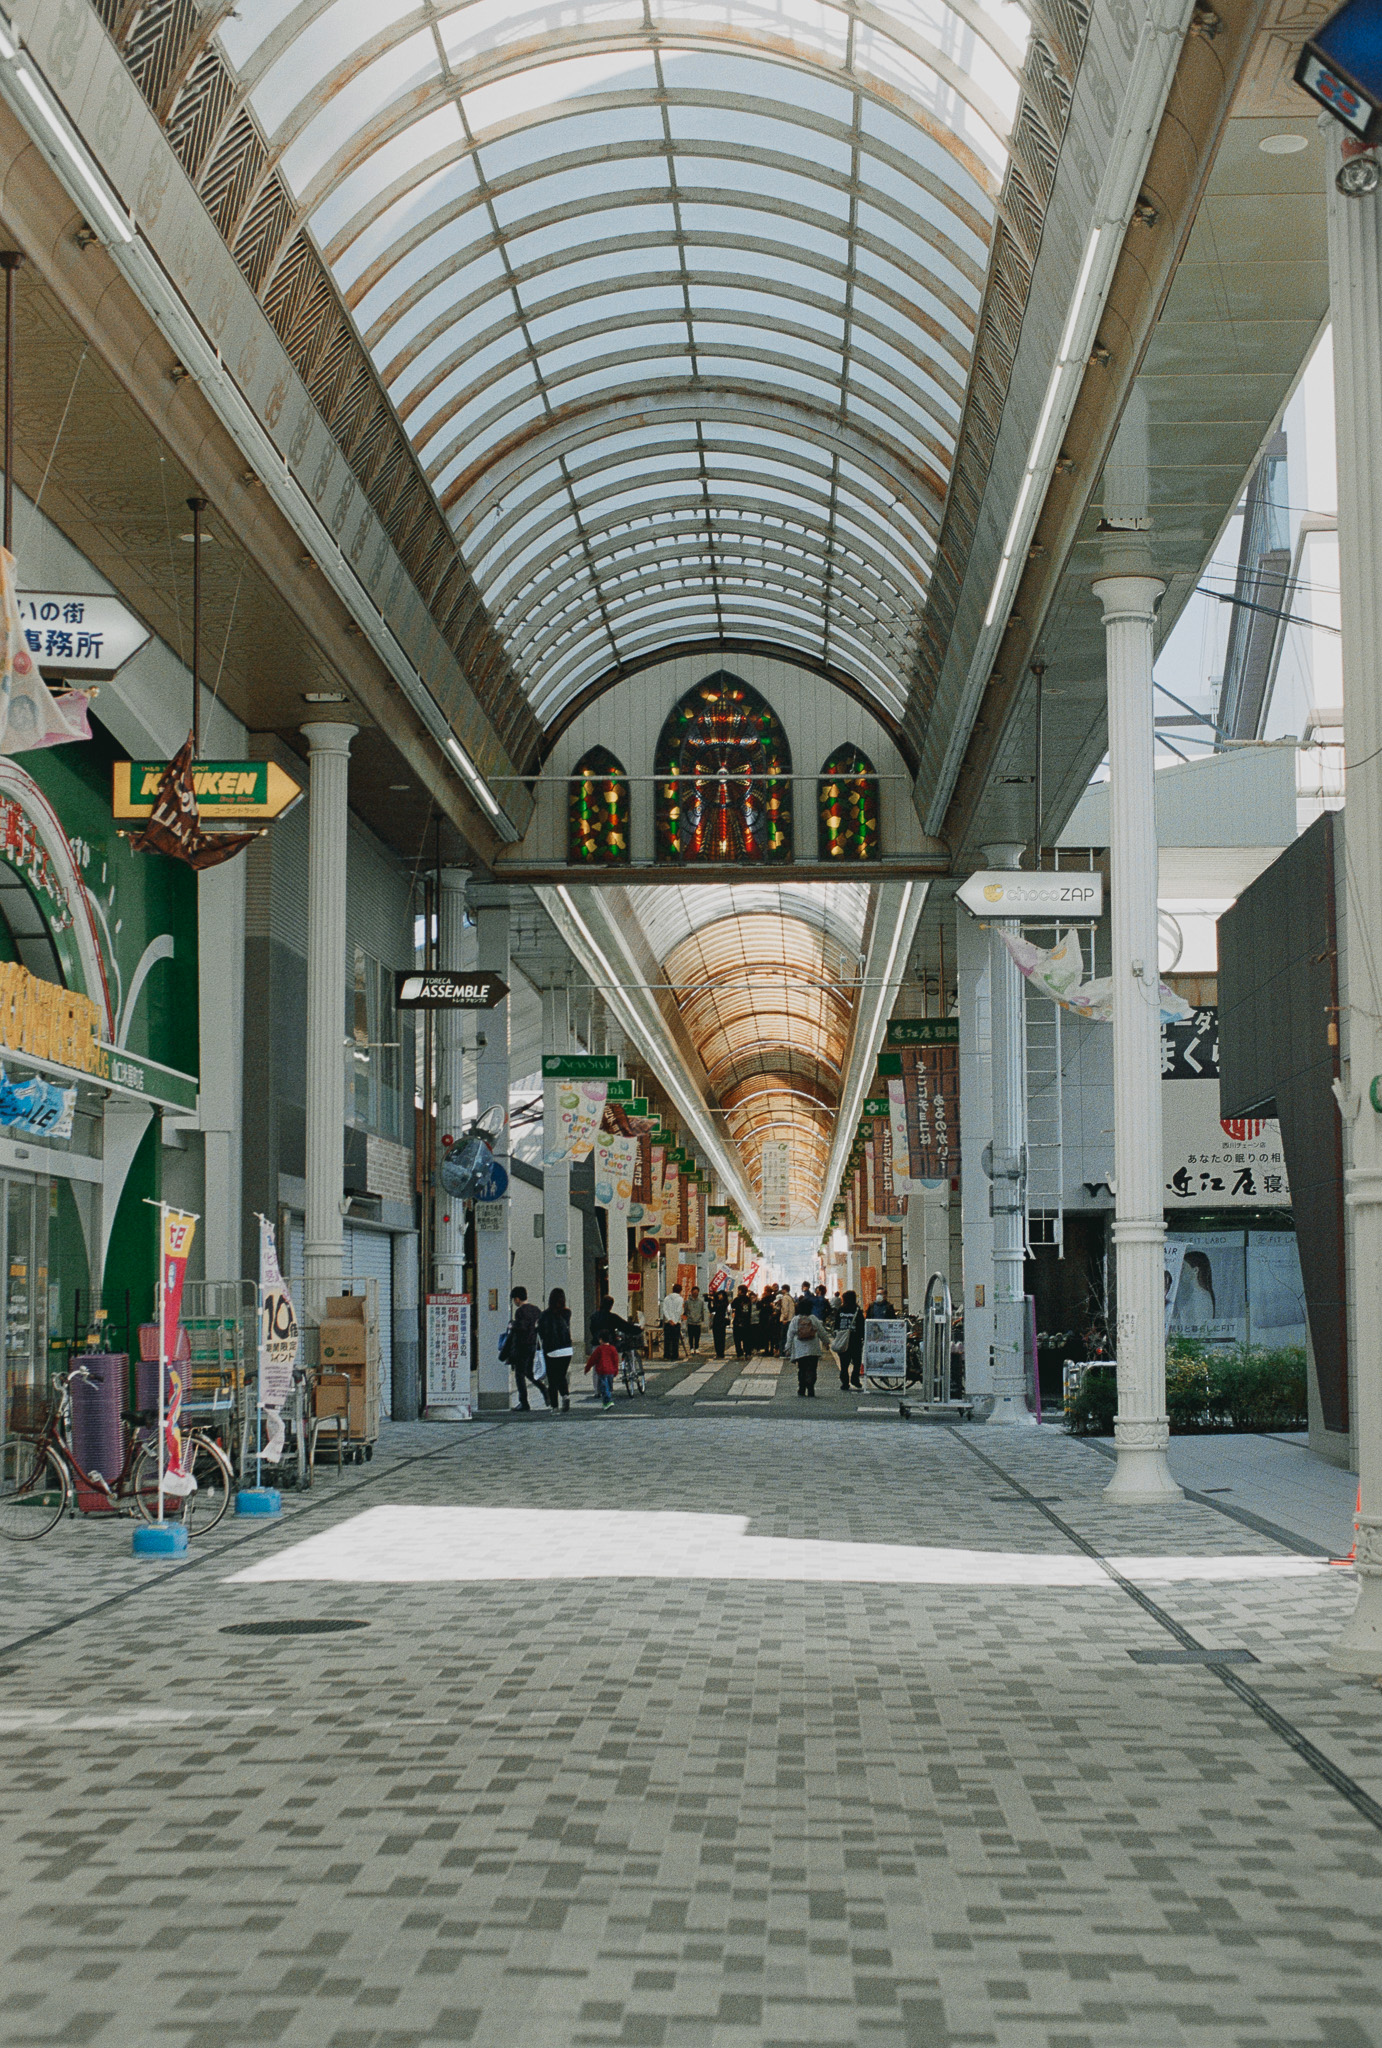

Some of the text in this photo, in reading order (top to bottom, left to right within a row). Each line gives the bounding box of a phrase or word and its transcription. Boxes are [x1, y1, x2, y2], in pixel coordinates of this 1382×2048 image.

[25, 628, 104, 659] 事務所
[1006, 886, 1095, 902] chocoZAP
[425, 977, 452, 985] TORECA
[420, 984, 490, 998] ASSEMBLE
[599, 1149, 632, 1161] Choco
[1165, 1166, 1291, 1198] 近江屋寝
[1205, 1236, 1227, 1244] LABO
